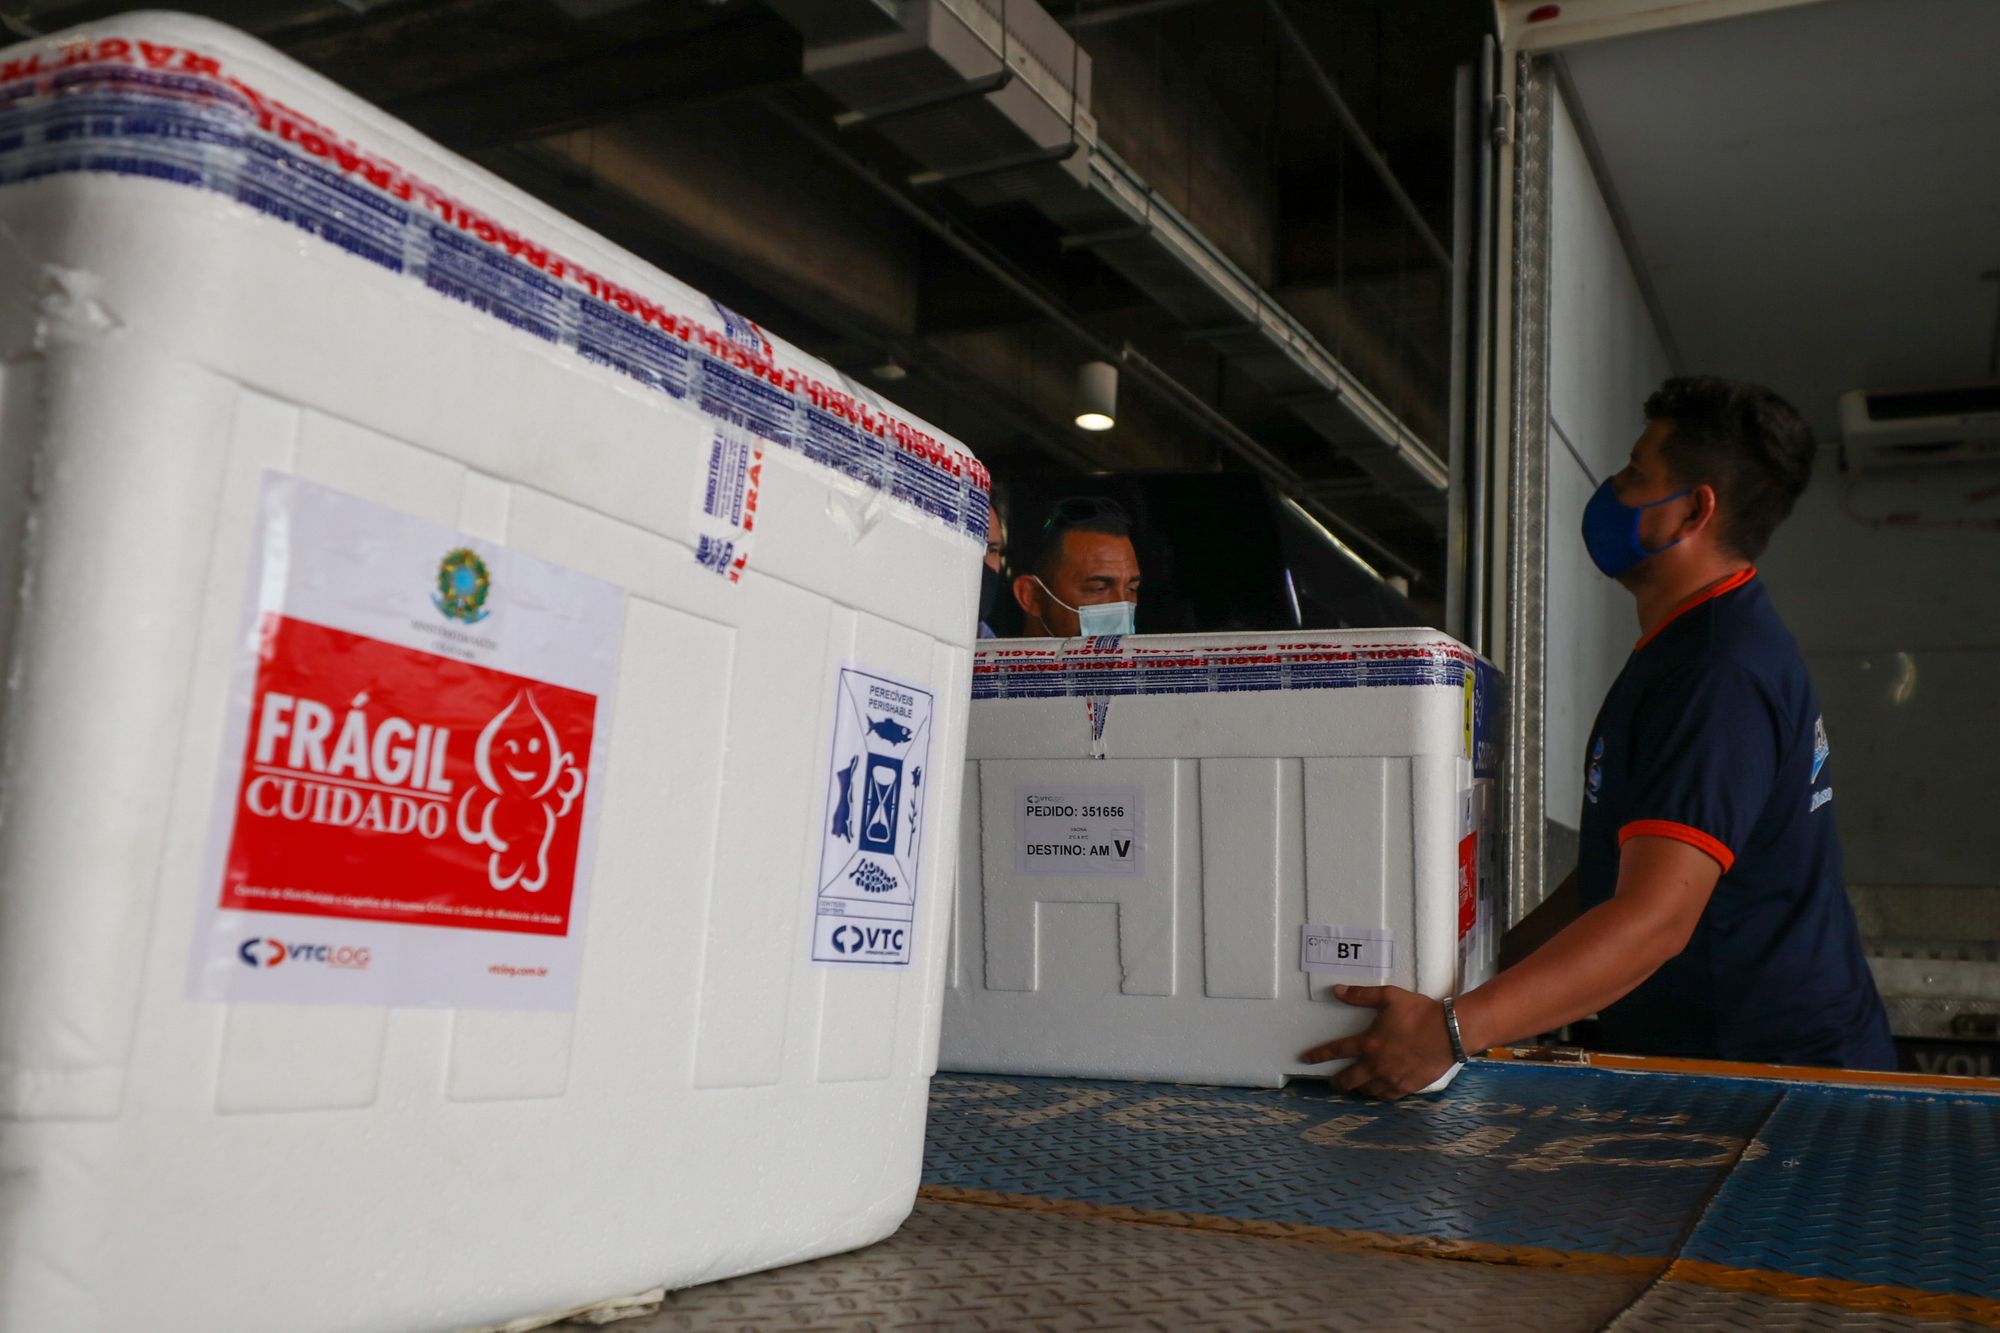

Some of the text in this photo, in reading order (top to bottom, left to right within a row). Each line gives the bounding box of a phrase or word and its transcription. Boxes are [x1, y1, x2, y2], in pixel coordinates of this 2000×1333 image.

[434, 198, 564, 284] FRÁGIL
[580, 274, 691, 345] FRÁGIL
[702, 334, 795, 400] FRÁGIL
[807, 386, 885, 445] FRÁGIL
[894, 430, 960, 481] FRÁGIL
[870, 685, 913, 706] PERECÍVEIS
[868, 698, 912, 719] PERISHABLE
[254, 691, 454, 793] FRÁGIL
[246, 775, 448, 840] CUIDADO
[1026, 806, 1124, 817] PEDIDO: 351656
[1027, 845, 1110, 856] DESTINO: AM
[1114, 840, 1131, 857] V
[866, 927, 904, 951] VTC
[1337, 942, 1363, 959] BT
[286, 942, 370, 966] VTCLOG
